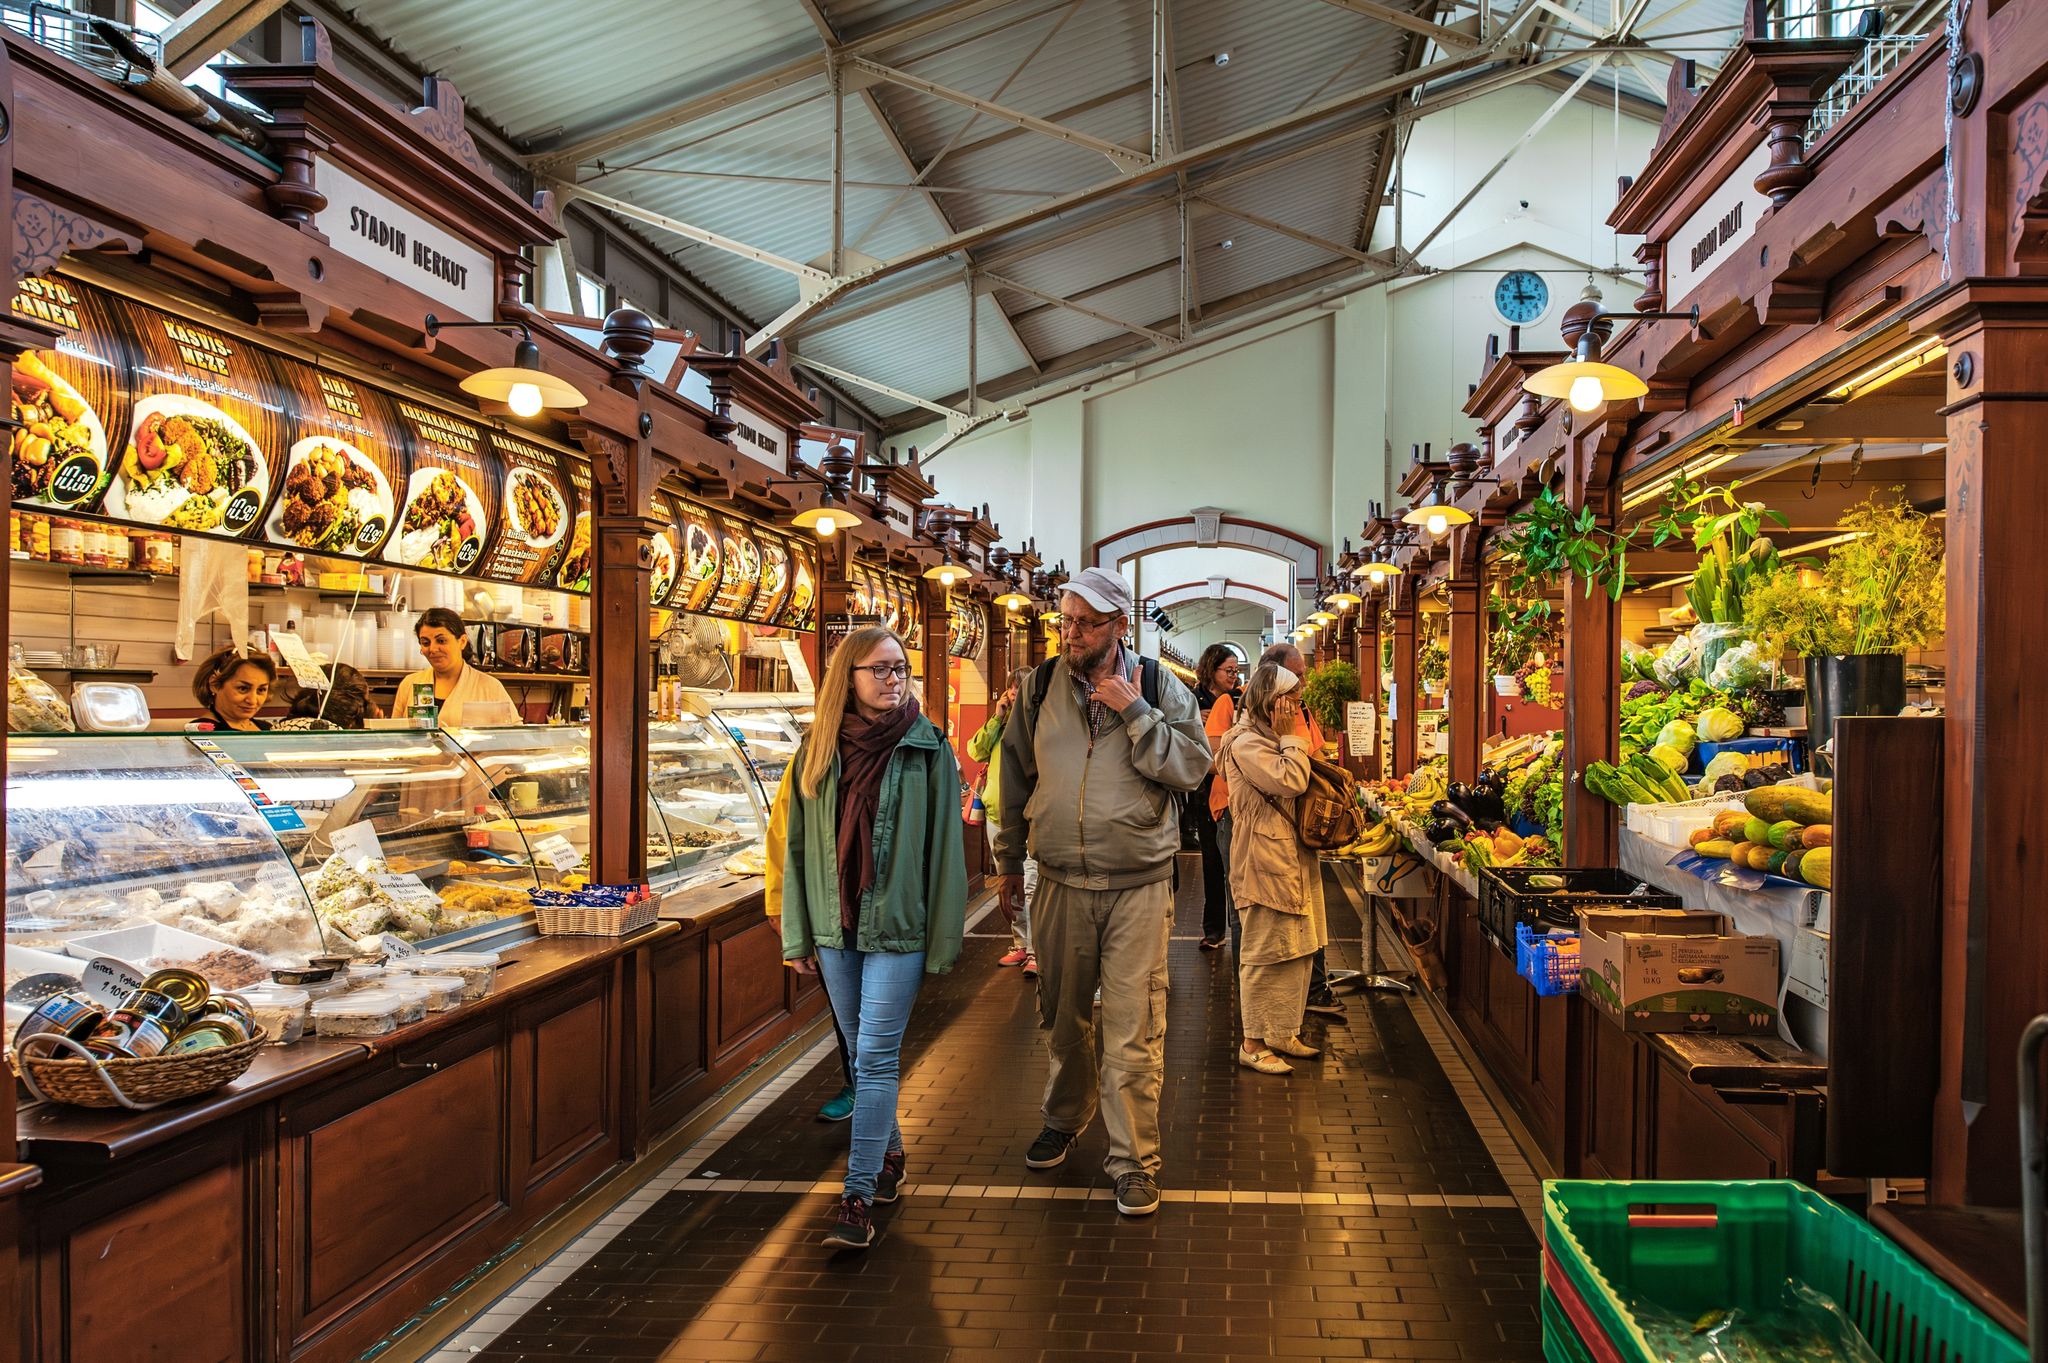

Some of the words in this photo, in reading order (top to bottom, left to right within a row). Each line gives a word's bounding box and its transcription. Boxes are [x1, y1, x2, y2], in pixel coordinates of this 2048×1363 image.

[350, 205, 406, 258] STADIN
[413, 239, 468, 291] HERKUT
[1691, 226, 1718, 273] BARAN
[1718, 200, 1744, 247] HALIT
[163, 319, 234, 358] KASVIS-
[179, 345, 230, 377] MEZE
[317, 373, 355, 398] LIHA-
[323, 392, 363, 418] MEZE
[399, 402, 480, 441] KREIKKALAINEN
[418, 424, 476, 455] MOUSSAKA
